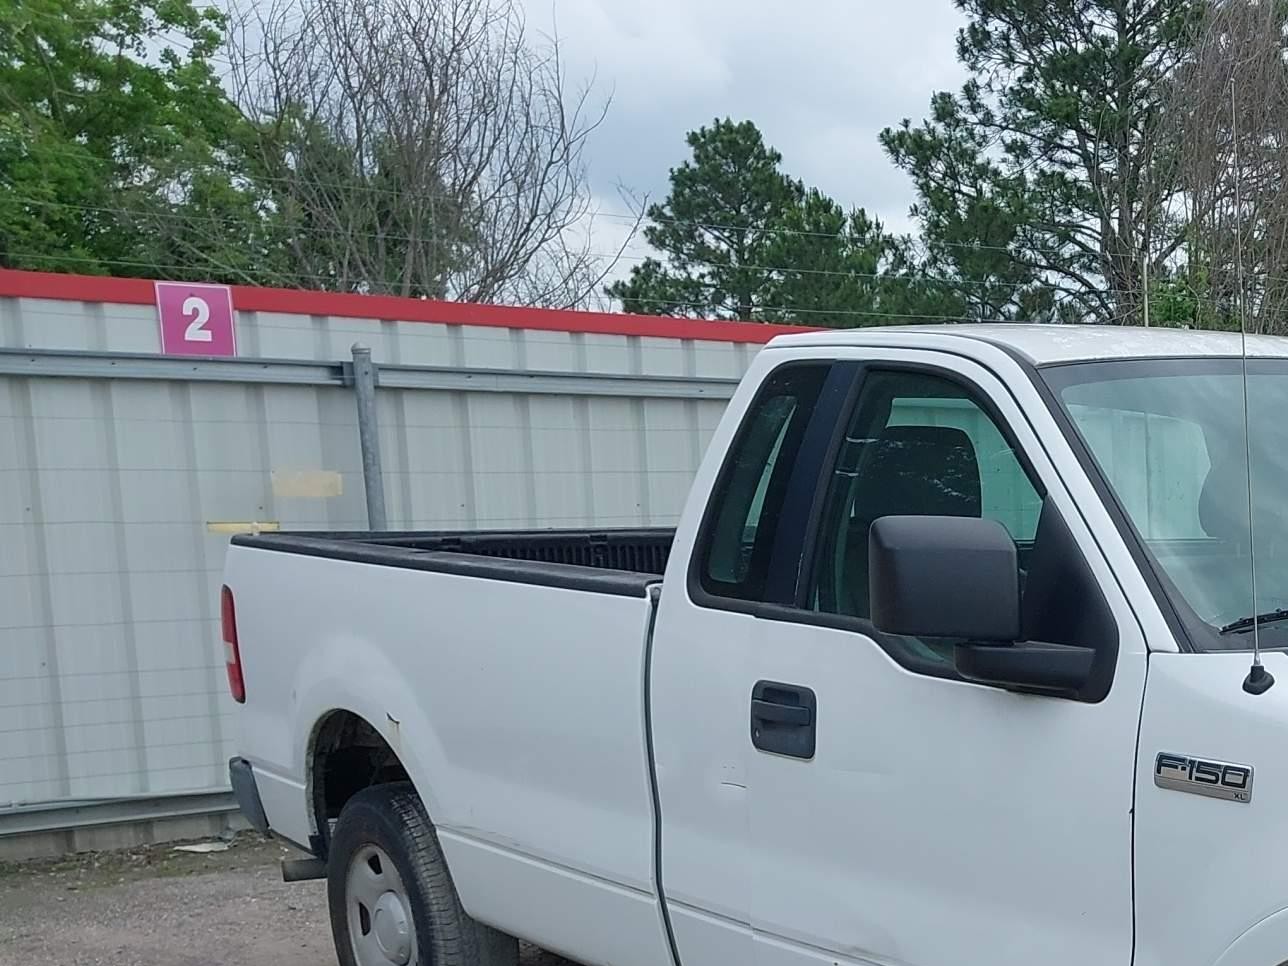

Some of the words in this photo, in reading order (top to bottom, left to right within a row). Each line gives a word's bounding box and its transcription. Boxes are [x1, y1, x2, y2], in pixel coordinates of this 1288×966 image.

[182, 296, 213, 342] 2
[1156, 754, 1251, 789] F-150
[1233, 792, 1247, 801] XL
